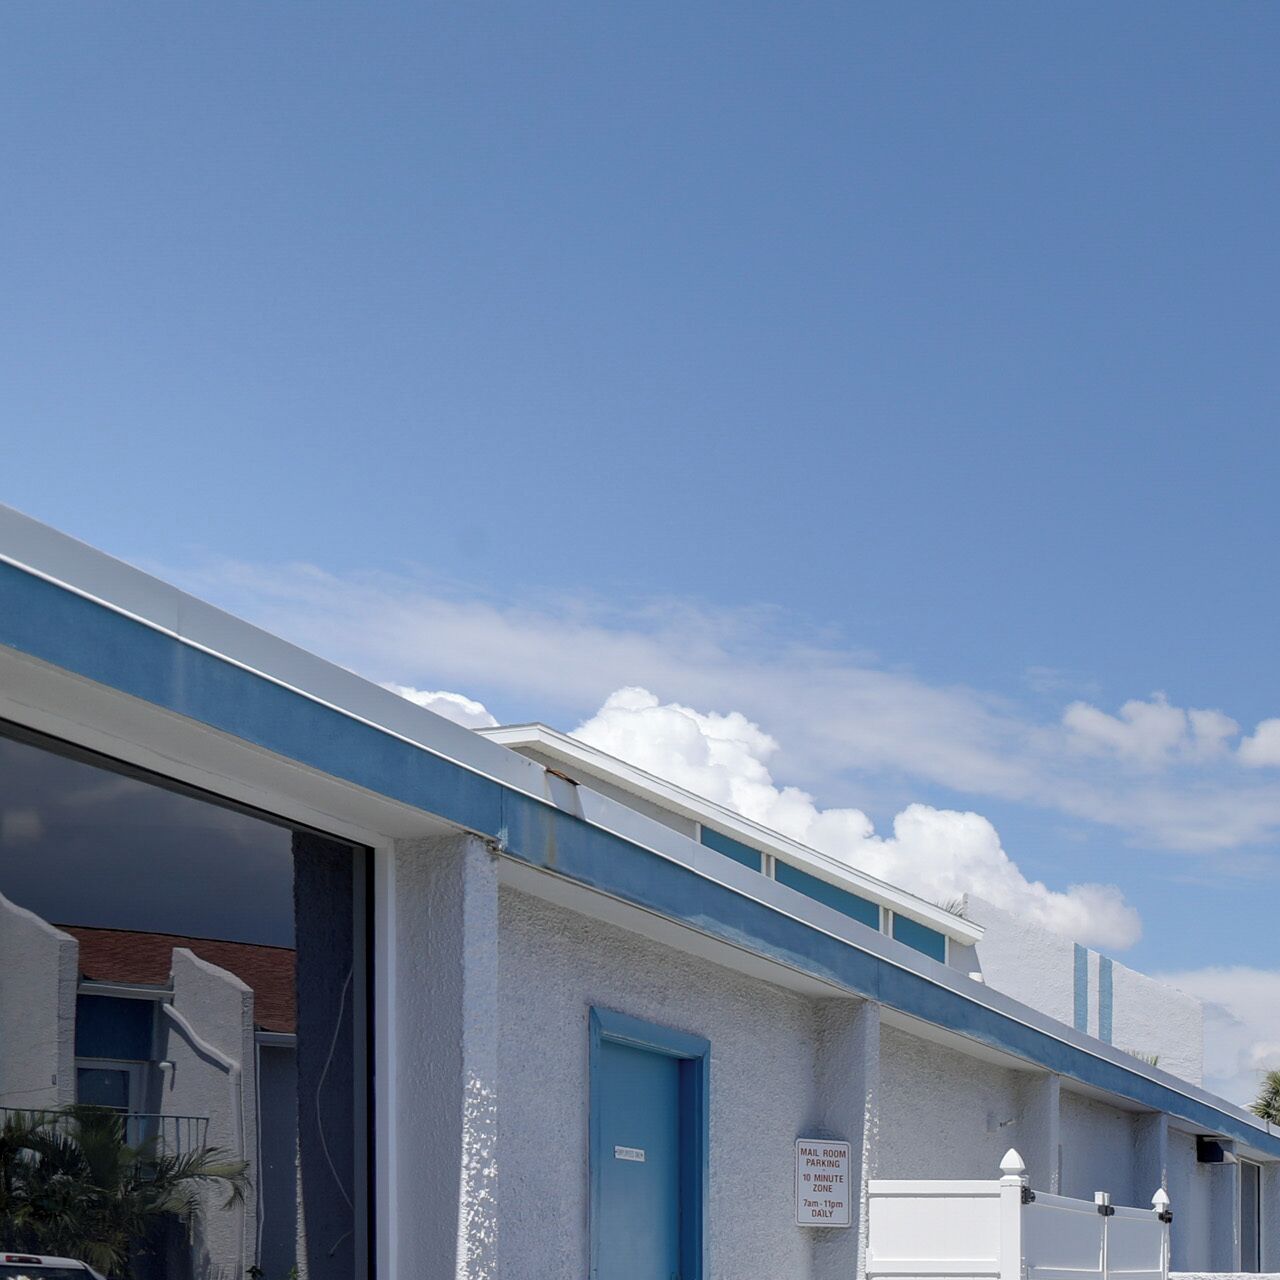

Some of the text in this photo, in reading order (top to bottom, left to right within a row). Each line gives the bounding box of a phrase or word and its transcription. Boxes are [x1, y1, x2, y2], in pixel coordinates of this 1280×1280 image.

[800, 1148, 846, 1158] MAIL ROOM
[806, 1159, 840, 1168] PARKING
[802, 1173, 844, 1183] 10 MINUTE
[813, 1184, 833, 1192] ZONE
[811, 1209, 834, 1218] DAILY
